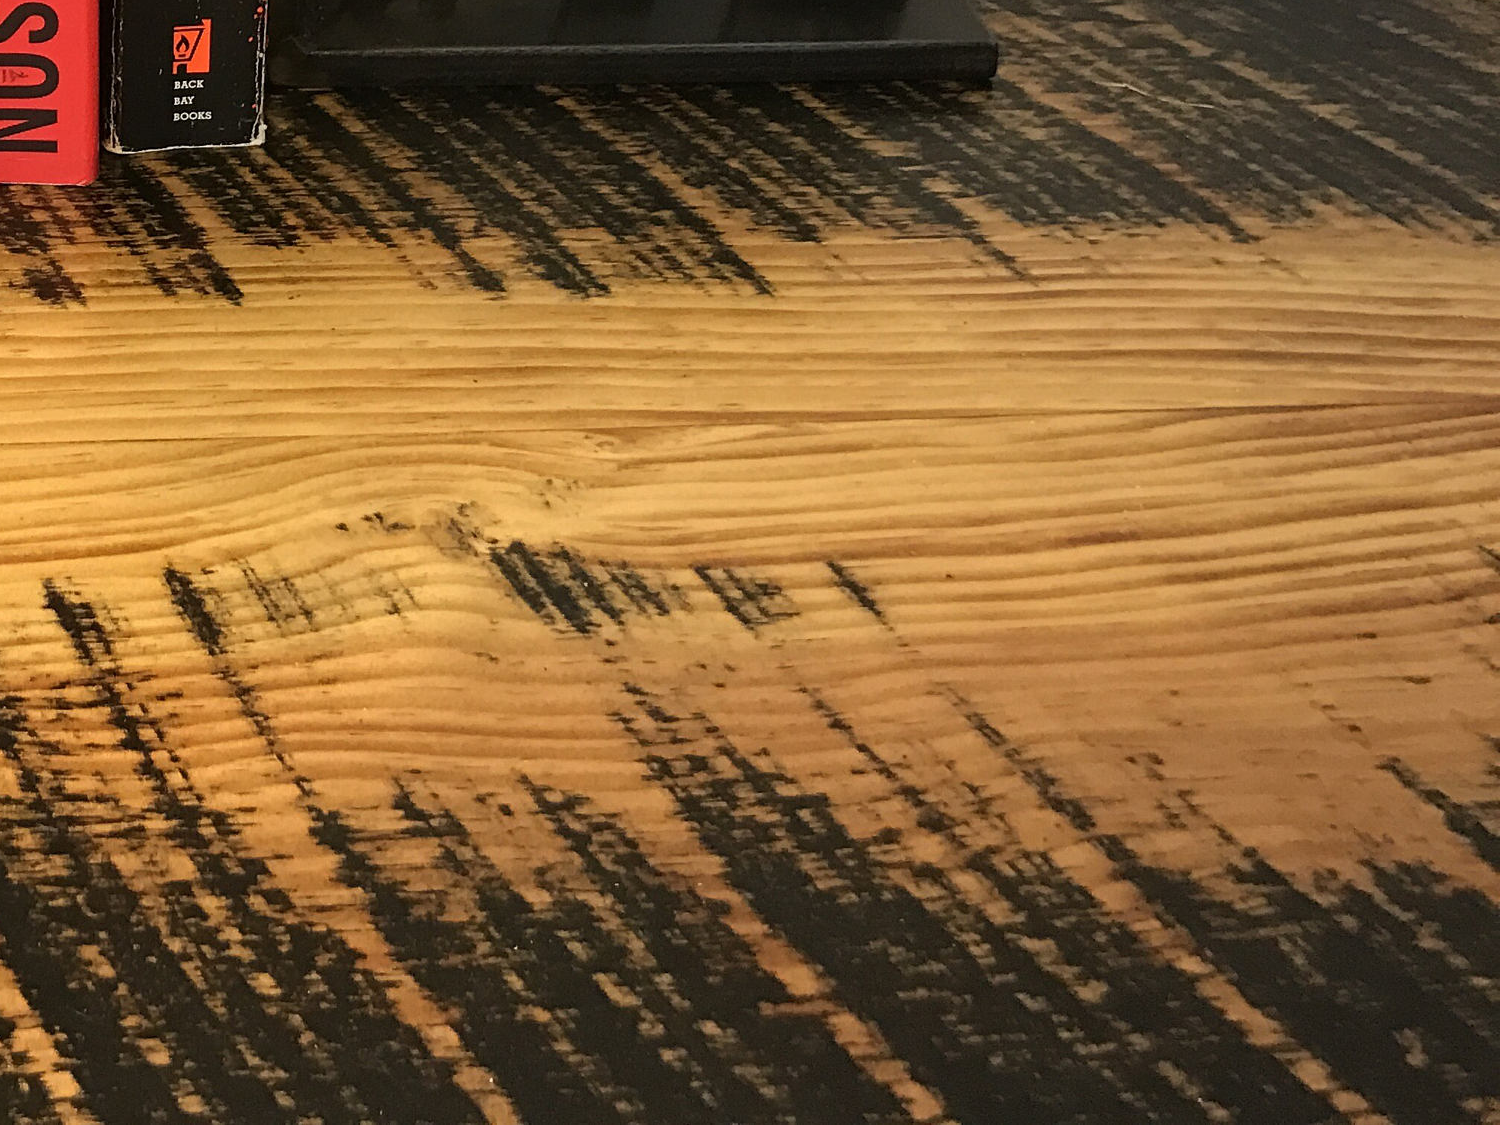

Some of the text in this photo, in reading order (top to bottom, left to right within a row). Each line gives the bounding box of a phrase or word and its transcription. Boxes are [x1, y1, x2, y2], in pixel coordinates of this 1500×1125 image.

[173, 79, 204, 90] BACK
[173, 95, 195, 106] BAY
[173, 111, 212, 122] BOOKS
